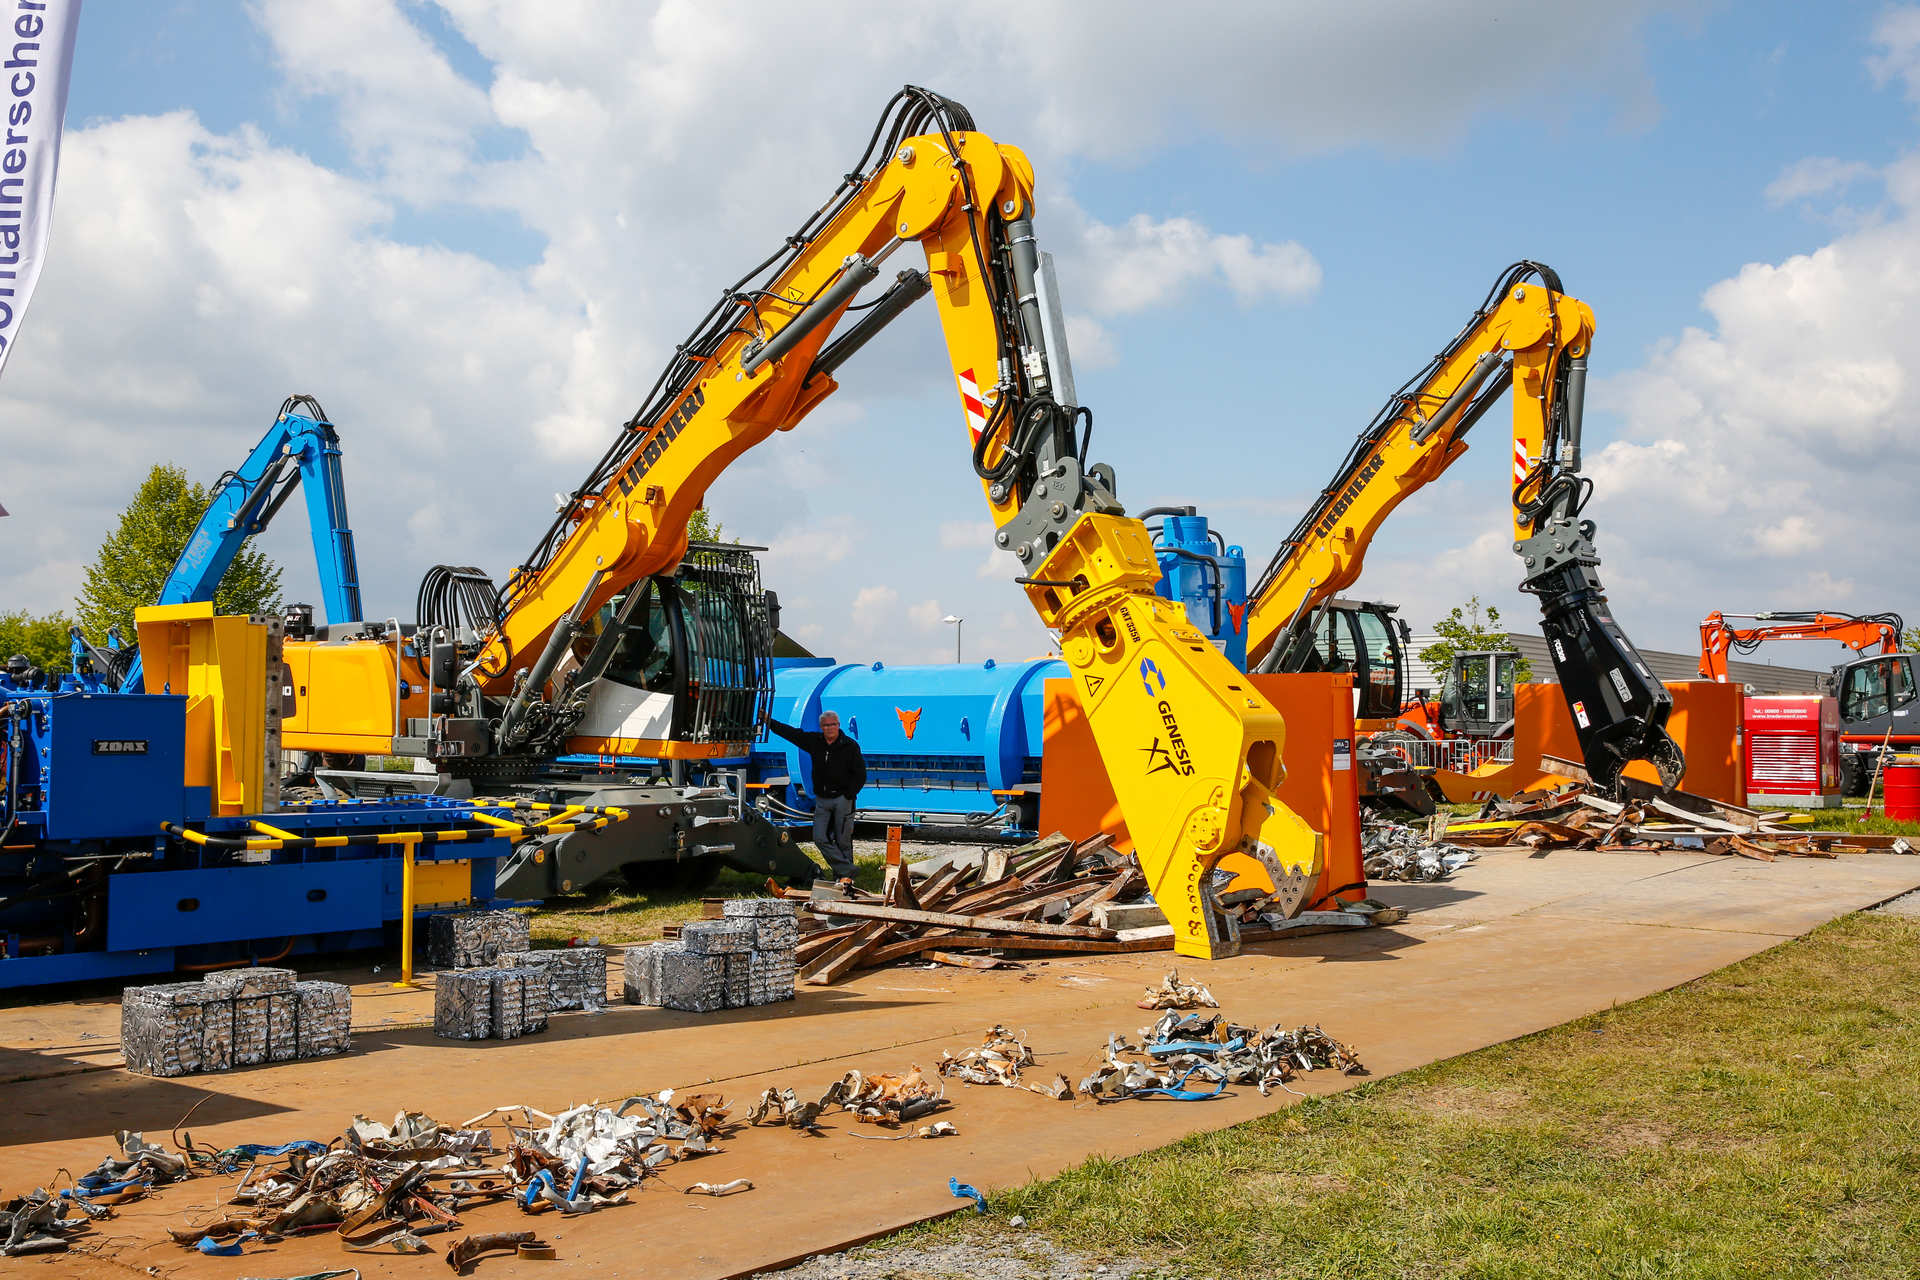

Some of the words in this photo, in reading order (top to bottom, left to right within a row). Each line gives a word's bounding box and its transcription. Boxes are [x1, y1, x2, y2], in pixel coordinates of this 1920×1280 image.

[0, 0, 47, 358] ntainerscher
[1314, 454, 1385, 539] LIEBHERR
[1157, 700, 1195, 777] GENESIS
